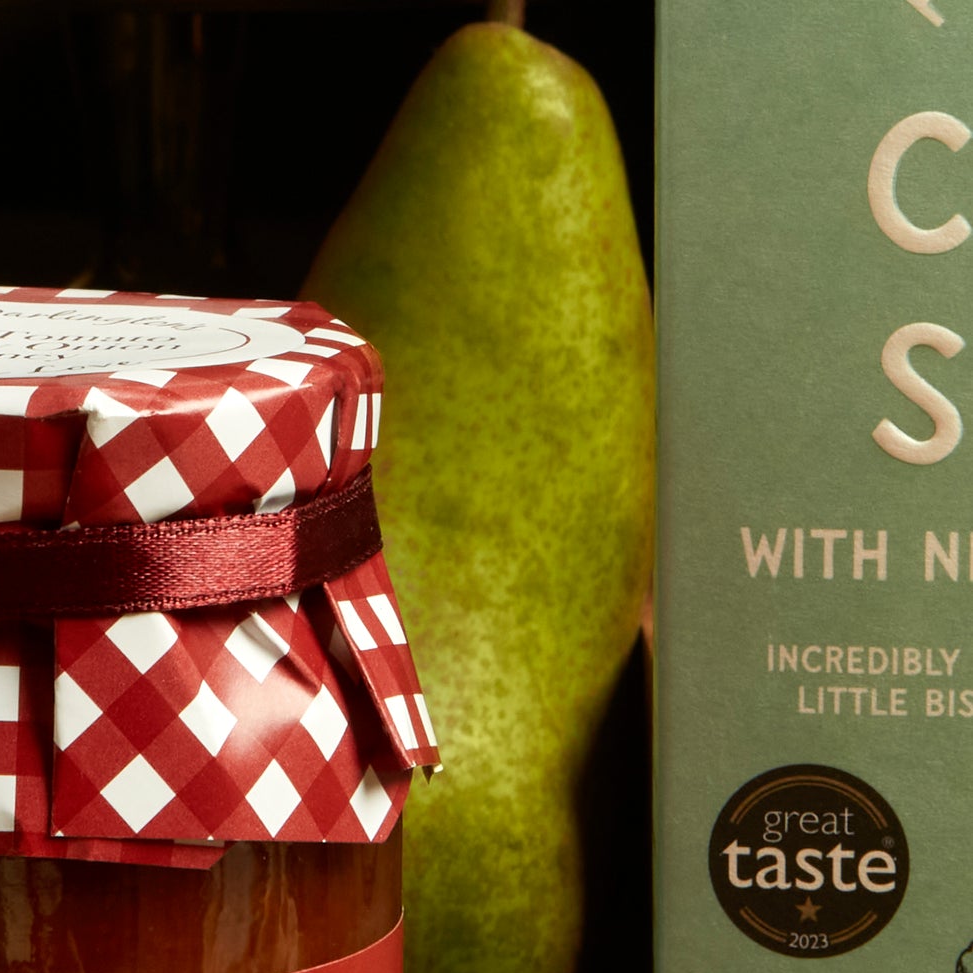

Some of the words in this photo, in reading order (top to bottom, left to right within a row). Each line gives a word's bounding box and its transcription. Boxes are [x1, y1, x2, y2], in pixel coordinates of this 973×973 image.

[740, 526, 888, 581] WITH
[924, 530, 973, 582] N
[767, 644, 961, 677] INCREDIBLY
[798, 686, 908, 716] LITTLE
[763, 807, 855, 843] great
[721, 839, 897, 893] taste
[788, 931, 829, 950] 2023
